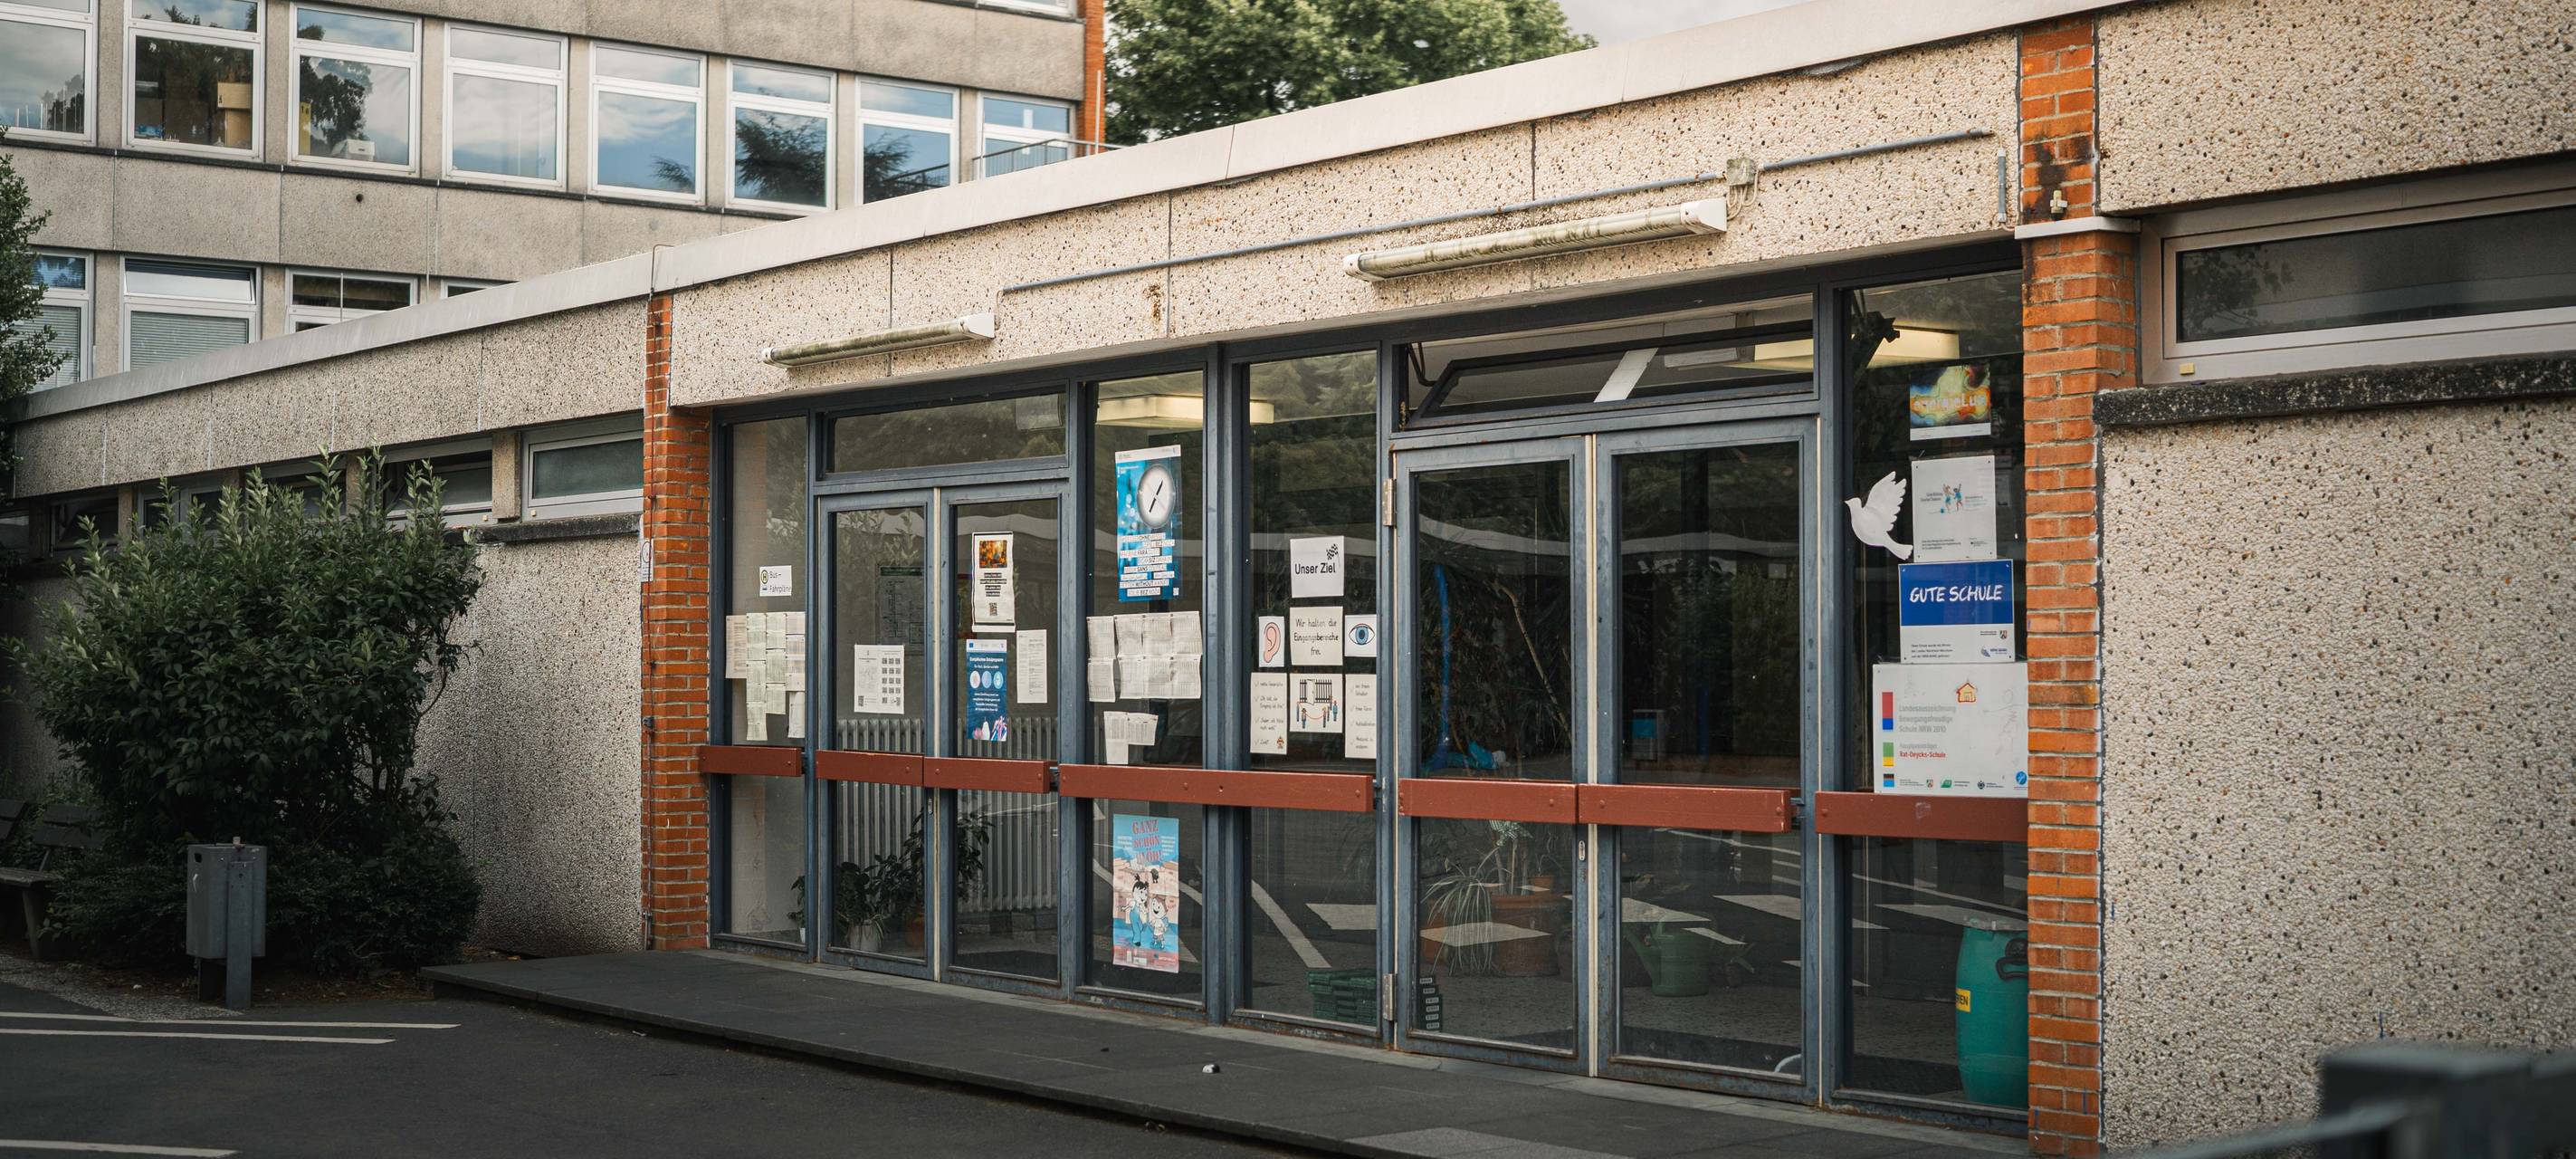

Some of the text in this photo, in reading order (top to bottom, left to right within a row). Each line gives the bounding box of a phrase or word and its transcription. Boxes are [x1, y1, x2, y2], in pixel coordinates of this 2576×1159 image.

[1294, 562, 1336, 575] Unser Ziel
[1910, 584, 2003, 603] GUTE SCHULE
[1295, 618, 1337, 627] Wir halten die
[1293, 632, 1339, 643] Eingangsbereiche
[1899, 704, 1956, 714] Landesauszeichnung
[1899, 715, 1952, 724] Bewegungsfreudige
[1900, 751, 1946, 760] Rat-Deycks-Schule
[1132, 819, 1159, 834] GANZ
[1133, 834, 1159, 848] SCHÖN
